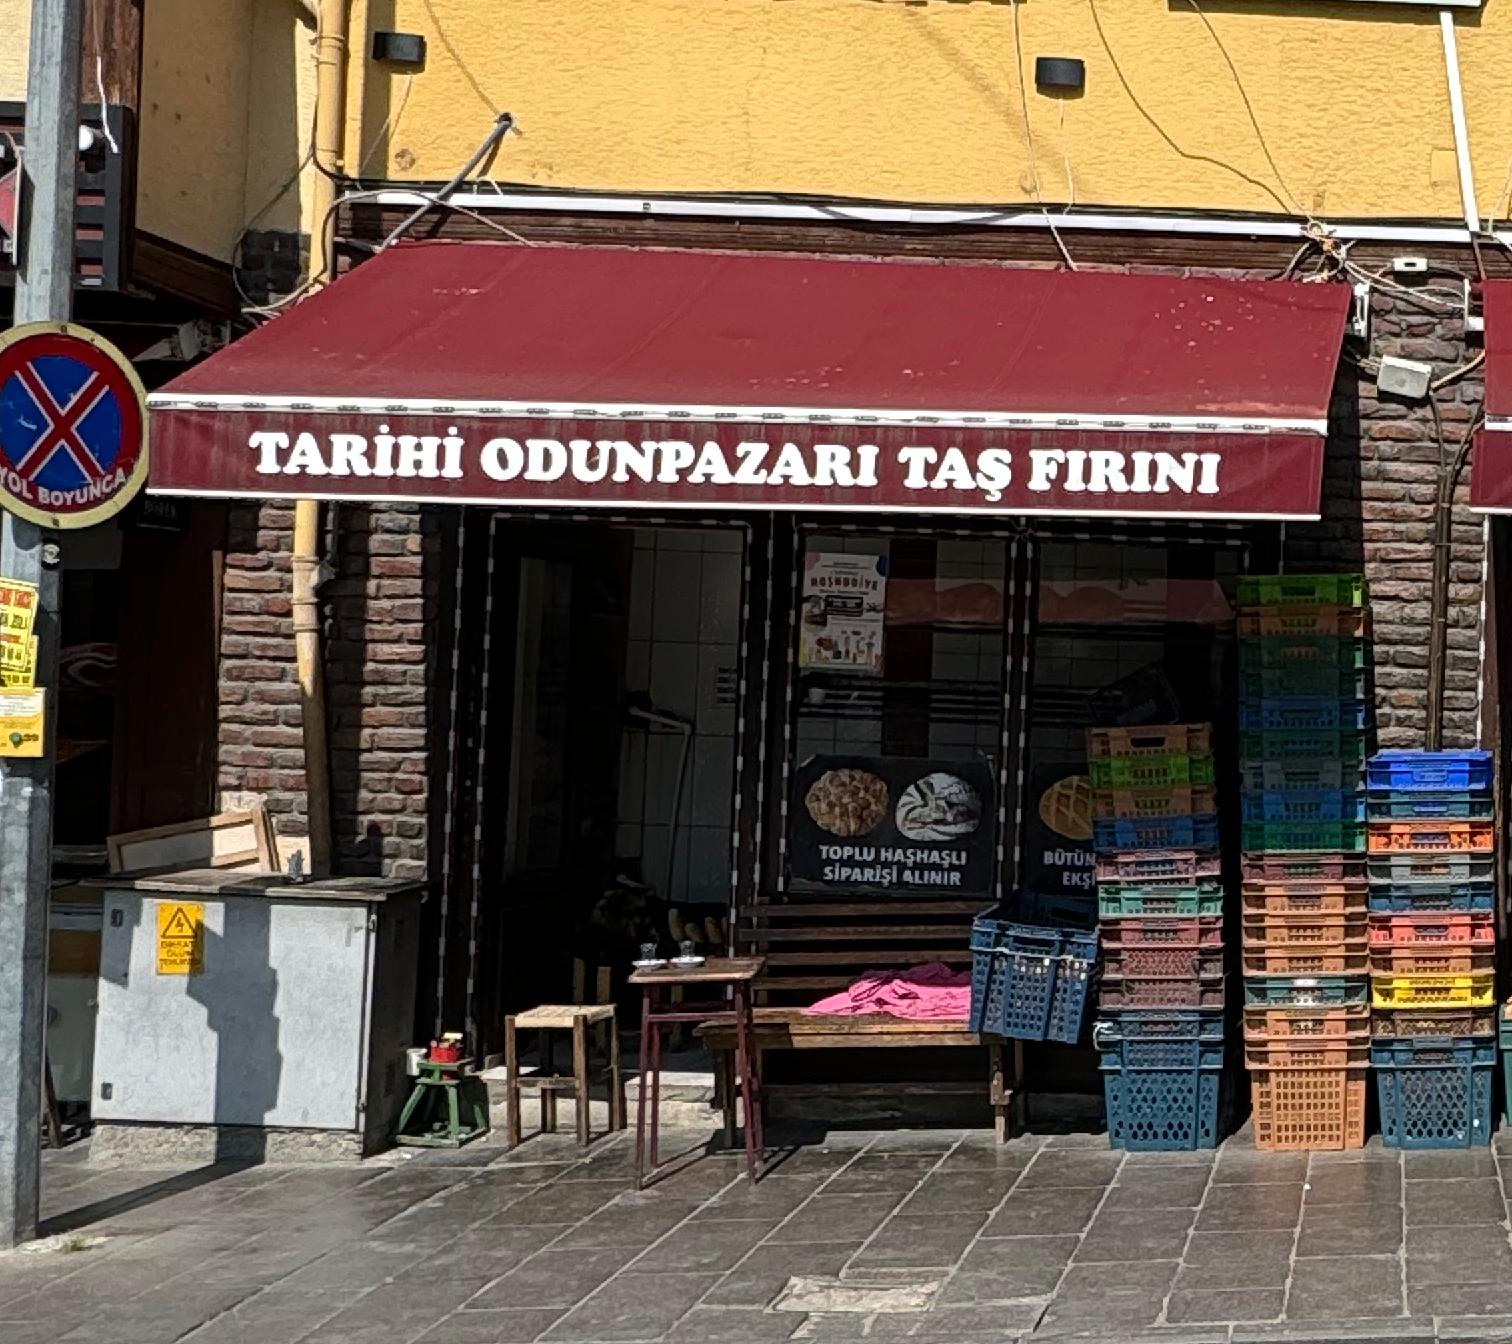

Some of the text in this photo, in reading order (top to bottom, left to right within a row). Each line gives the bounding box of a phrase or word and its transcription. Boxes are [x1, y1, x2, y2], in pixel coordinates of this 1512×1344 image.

[248, 424, 1222, 502] TARİHİ ODUNPAZARI TAŞ FIRINI
[38, 467, 126, 506] BOYUNCA
[819, 844, 967, 868] TOPLU HAŞHAŞLI
[822, 863, 962, 887] SİPARİŞİ ALINIR
